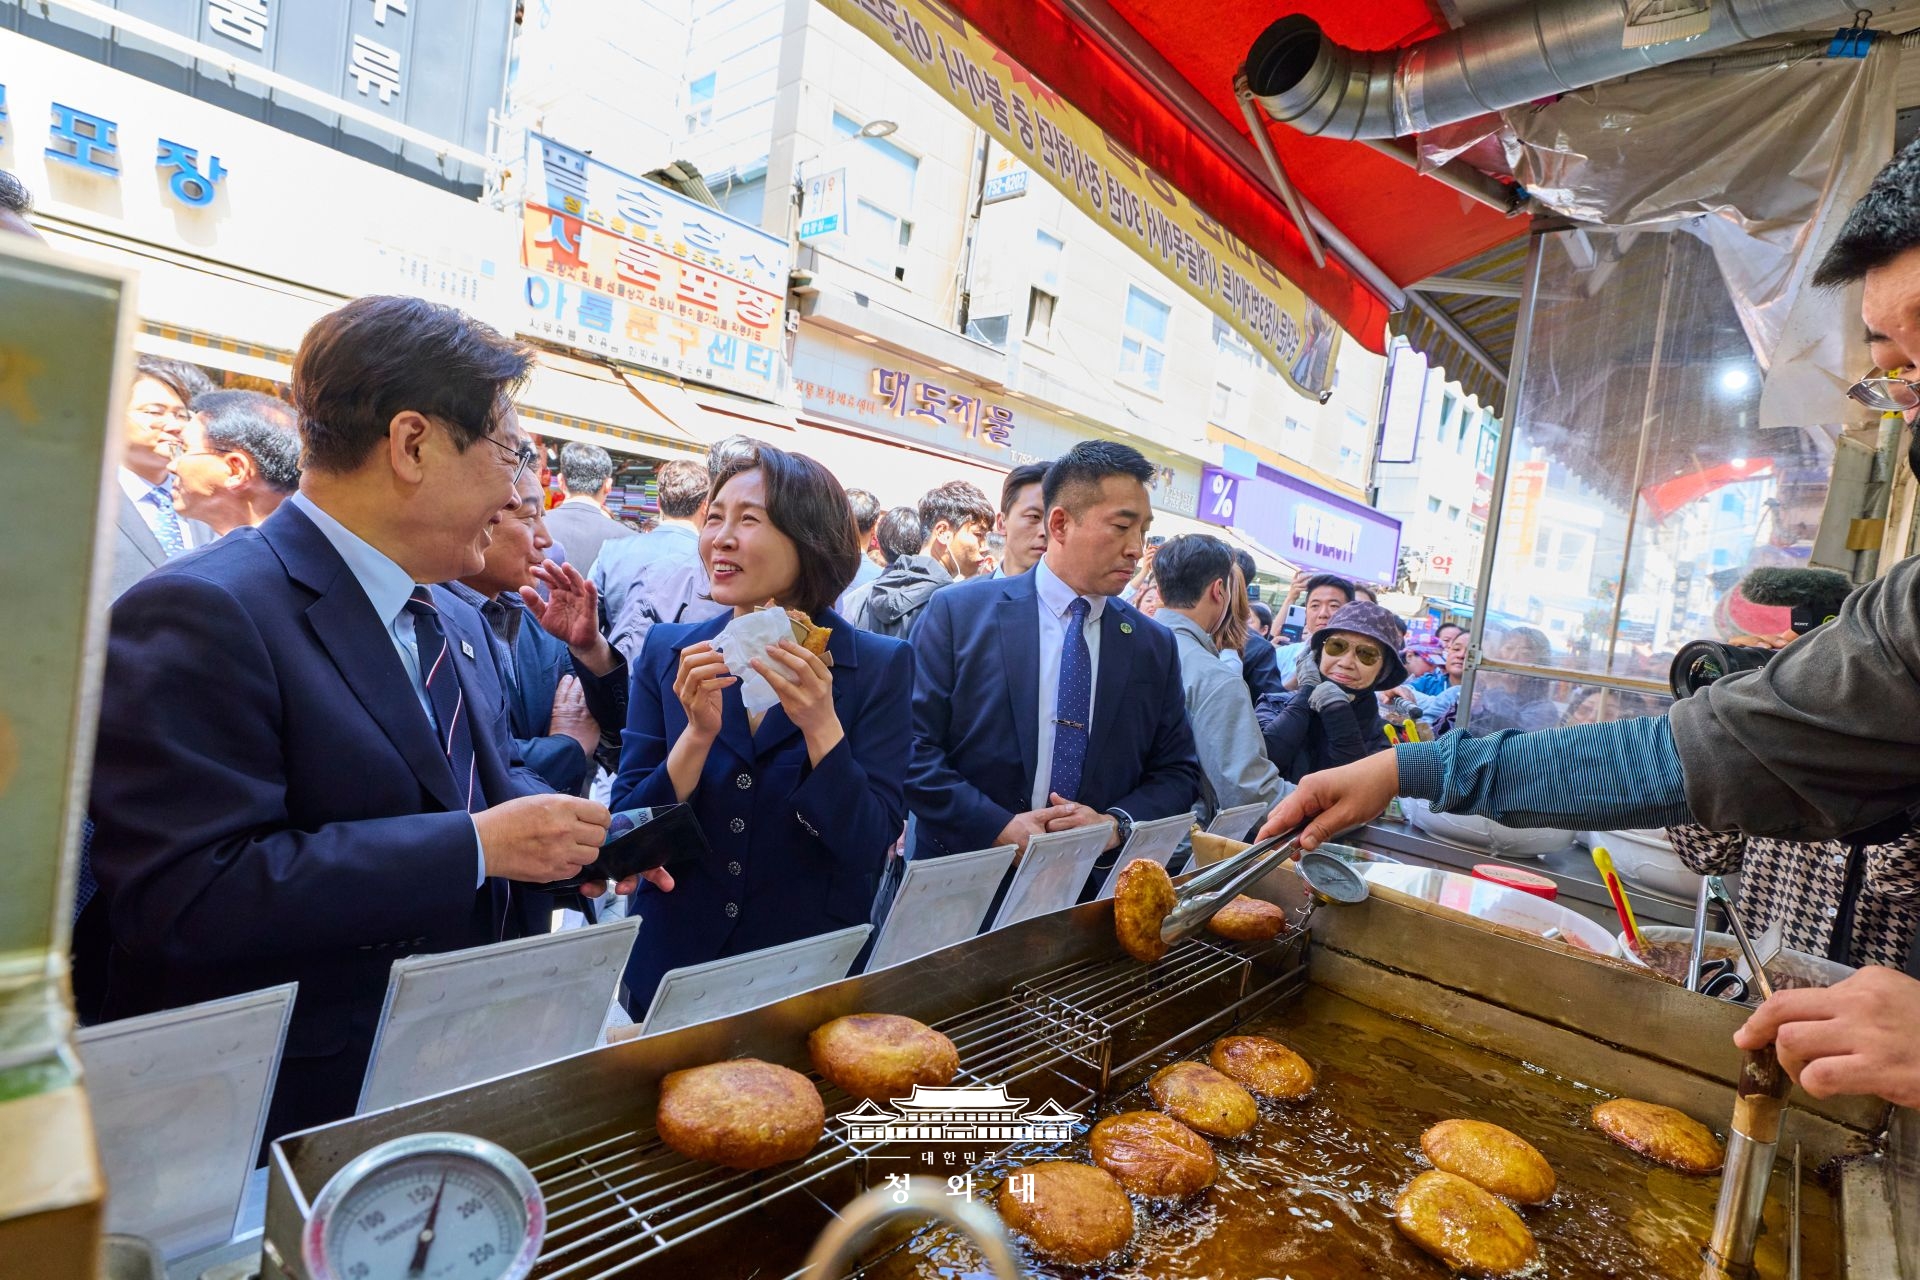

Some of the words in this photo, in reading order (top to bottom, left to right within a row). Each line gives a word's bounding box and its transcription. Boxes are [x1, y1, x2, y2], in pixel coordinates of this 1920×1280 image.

[0, 84, 228, 208] 포장
[874, 367, 1015, 448] 대도지물
[1432, 556, 1453, 575] 약
[406, 1184, 434, 1205] 150
[457, 1198, 483, 1219] 200
[357, 1210, 386, 1232] 100
[468, 1243, 495, 1266] 250
